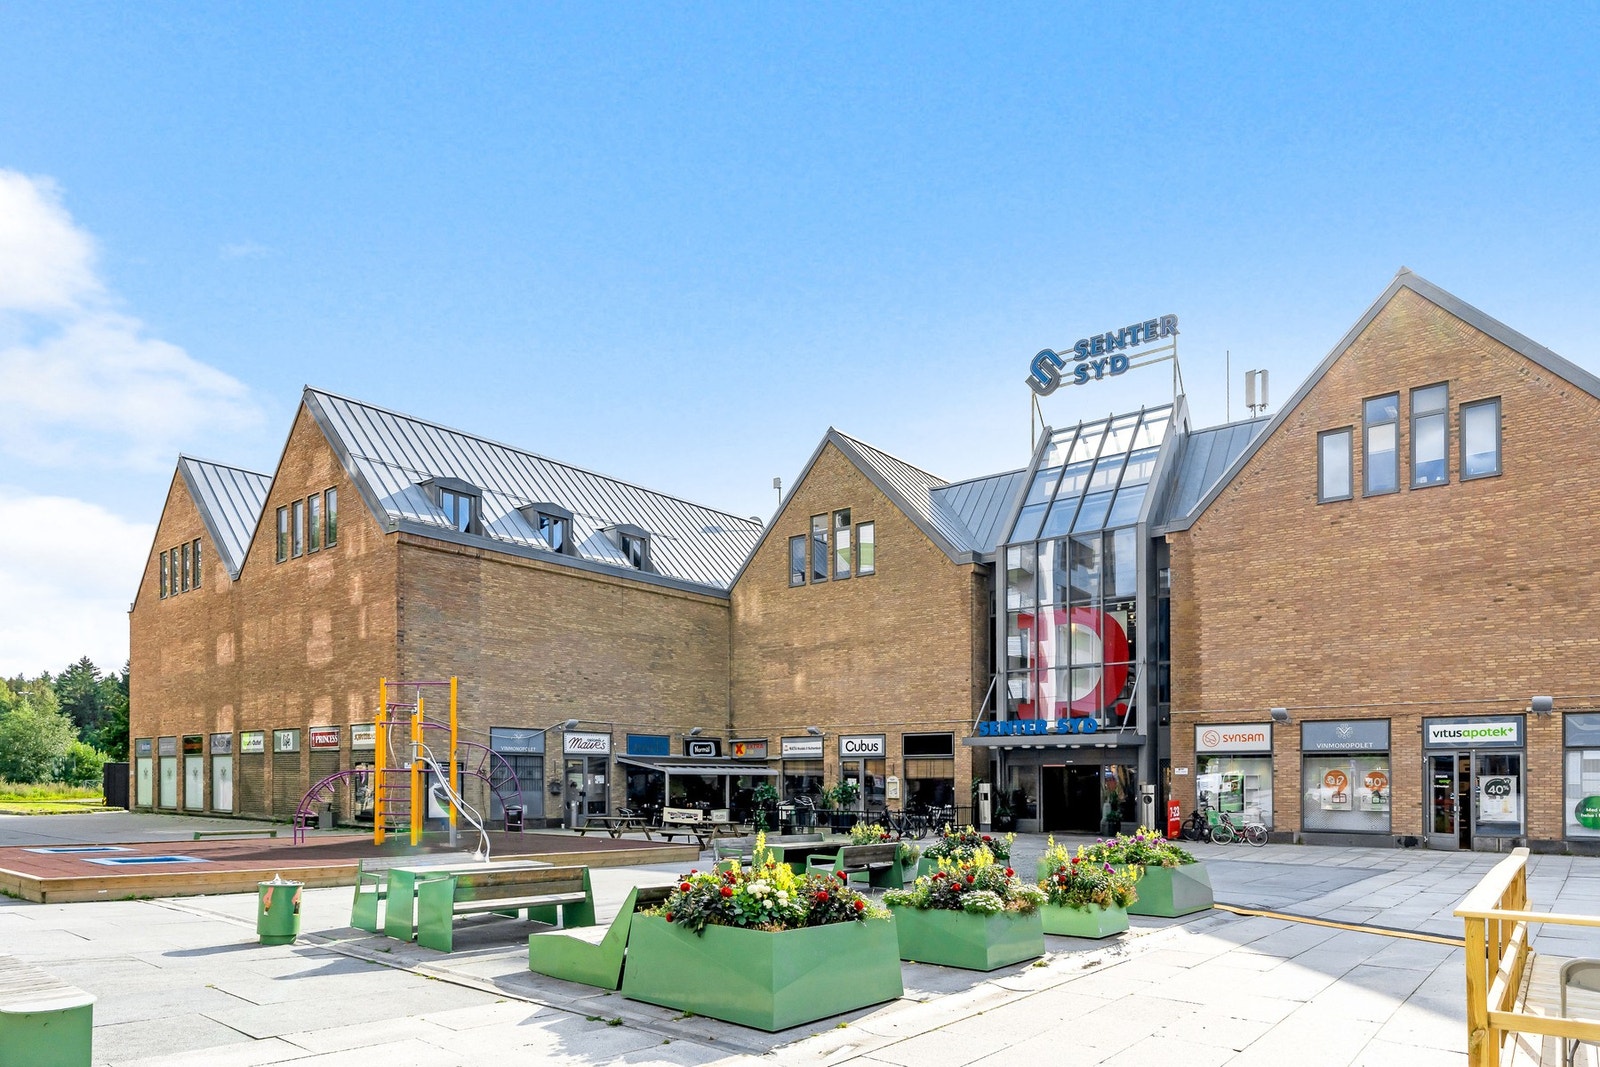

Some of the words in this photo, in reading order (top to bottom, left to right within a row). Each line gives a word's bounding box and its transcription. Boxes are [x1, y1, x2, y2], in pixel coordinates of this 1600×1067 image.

[1073, 313, 1180, 361] SENTER
[1073, 353, 1130, 386] SYD
[979, 718, 1048, 737] SENTER
[1056, 717, 1098, 735] SYD
[315, 734, 338, 744] PRINCESS
[1222, 733, 1265, 743] SYNSAM
[845, 739, 879, 752] Cubus
[1316, 742, 1374, 750] VINMONOPOLET
[1487, 785, 1509, 794] 40%
